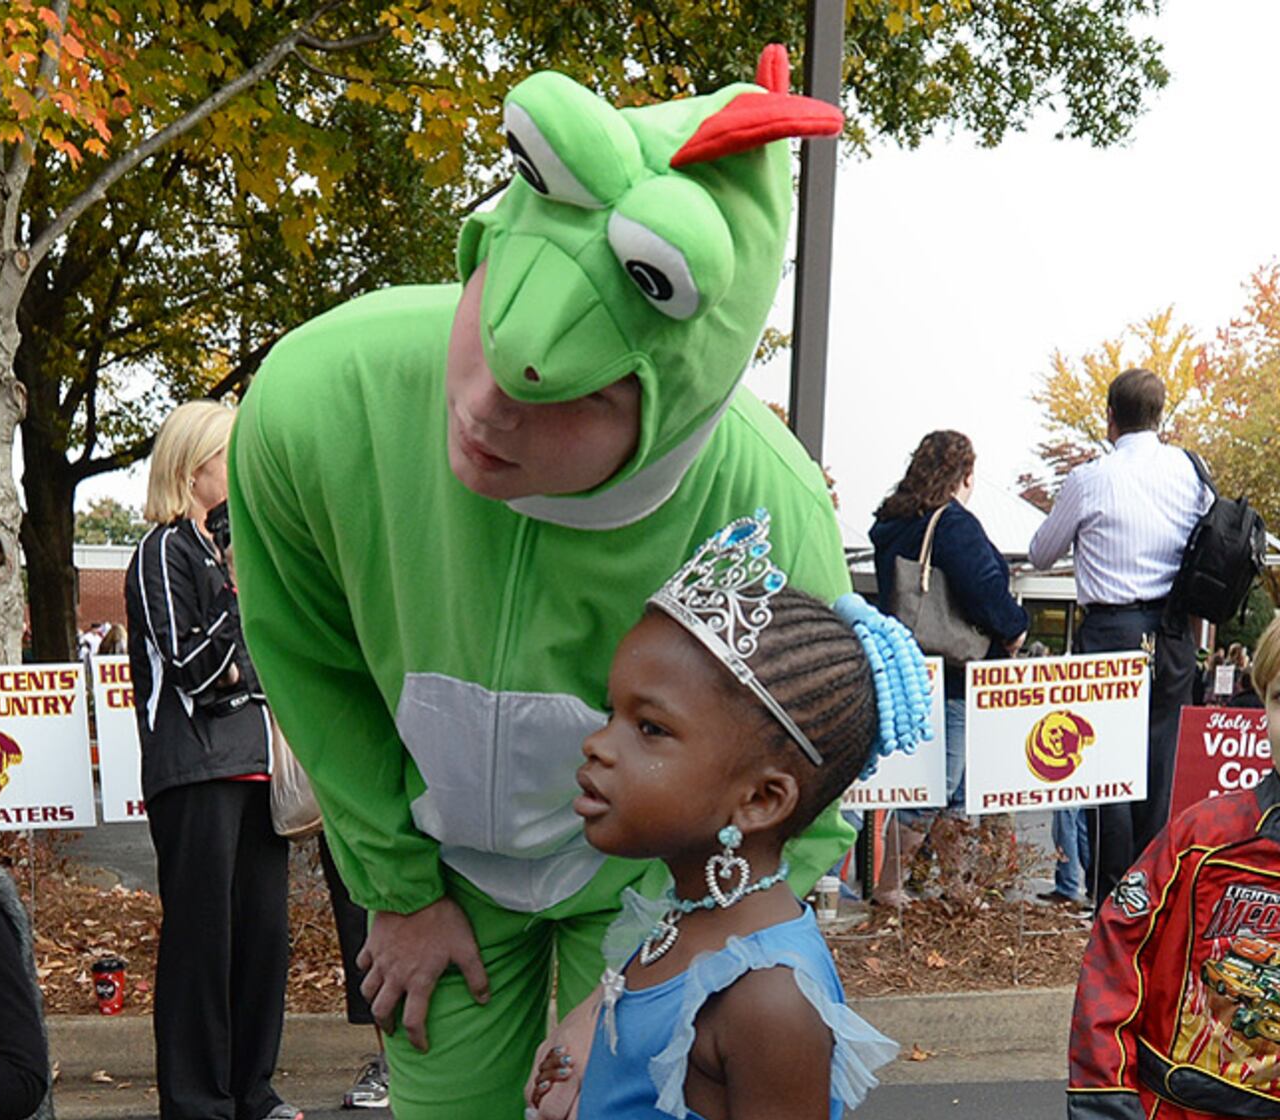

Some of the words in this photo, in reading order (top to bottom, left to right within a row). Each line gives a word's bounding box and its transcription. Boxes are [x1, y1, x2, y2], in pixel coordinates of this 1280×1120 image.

[972, 664, 1028, 687] HOLY
[976, 687, 1046, 710] CROSS
[1048, 680, 1143, 705] COUNTRY
[1206, 712, 1252, 734] Holy
[982, 785, 1091, 809] PRESTON
[1095, 780, 1135, 799] HIX
